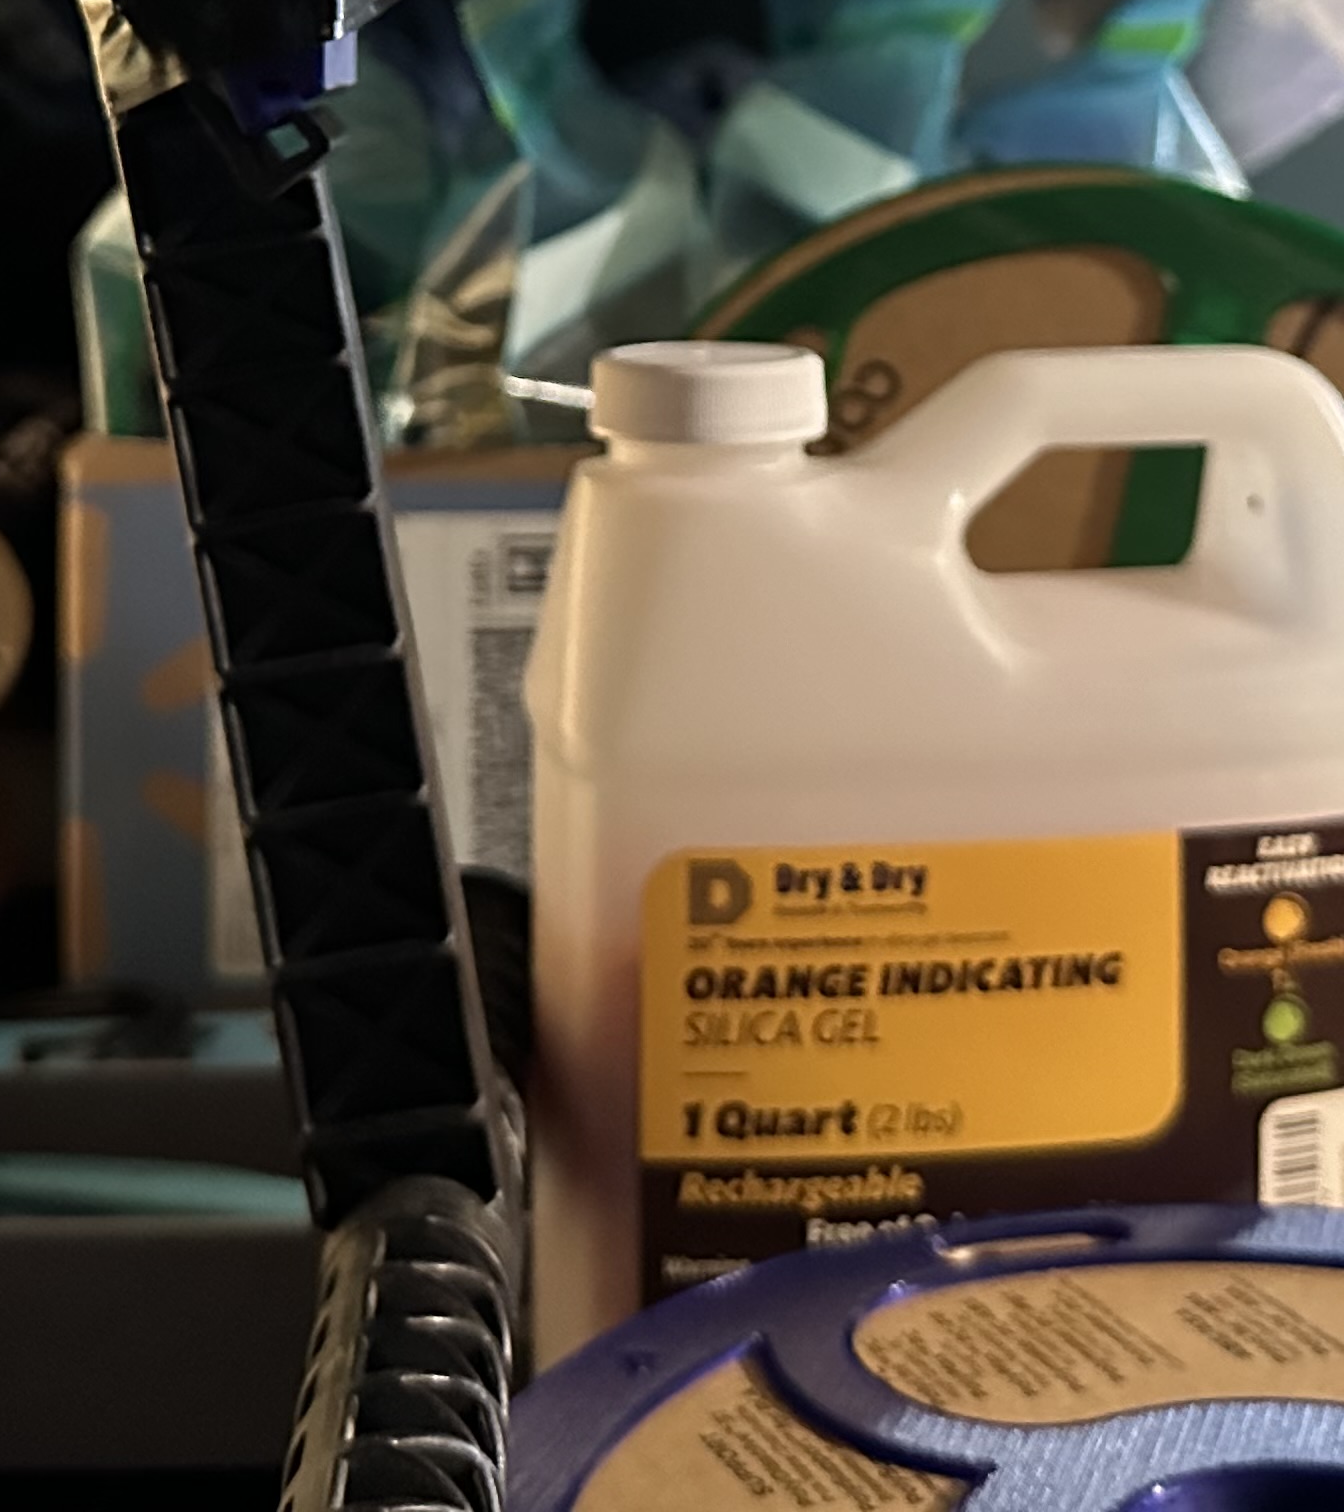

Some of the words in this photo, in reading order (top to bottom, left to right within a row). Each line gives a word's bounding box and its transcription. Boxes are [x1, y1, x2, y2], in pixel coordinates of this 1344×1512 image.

[774, 862, 832, 899] Dry
[841, 861, 862, 892] &
[870, 861, 927, 897] Dry
[684, 962, 870, 1000] ORANGE
[880, 951, 1123, 996] INDICATING
[683, 1008, 802, 1047] SILICA
[810, 1006, 881, 1045] GEL
[684, 1101, 702, 1138] 1
[715, 1099, 858, 1139] Quart
[866, 1102, 902, 1139] (2
[679, 1165, 924, 1216] Rechargeable
